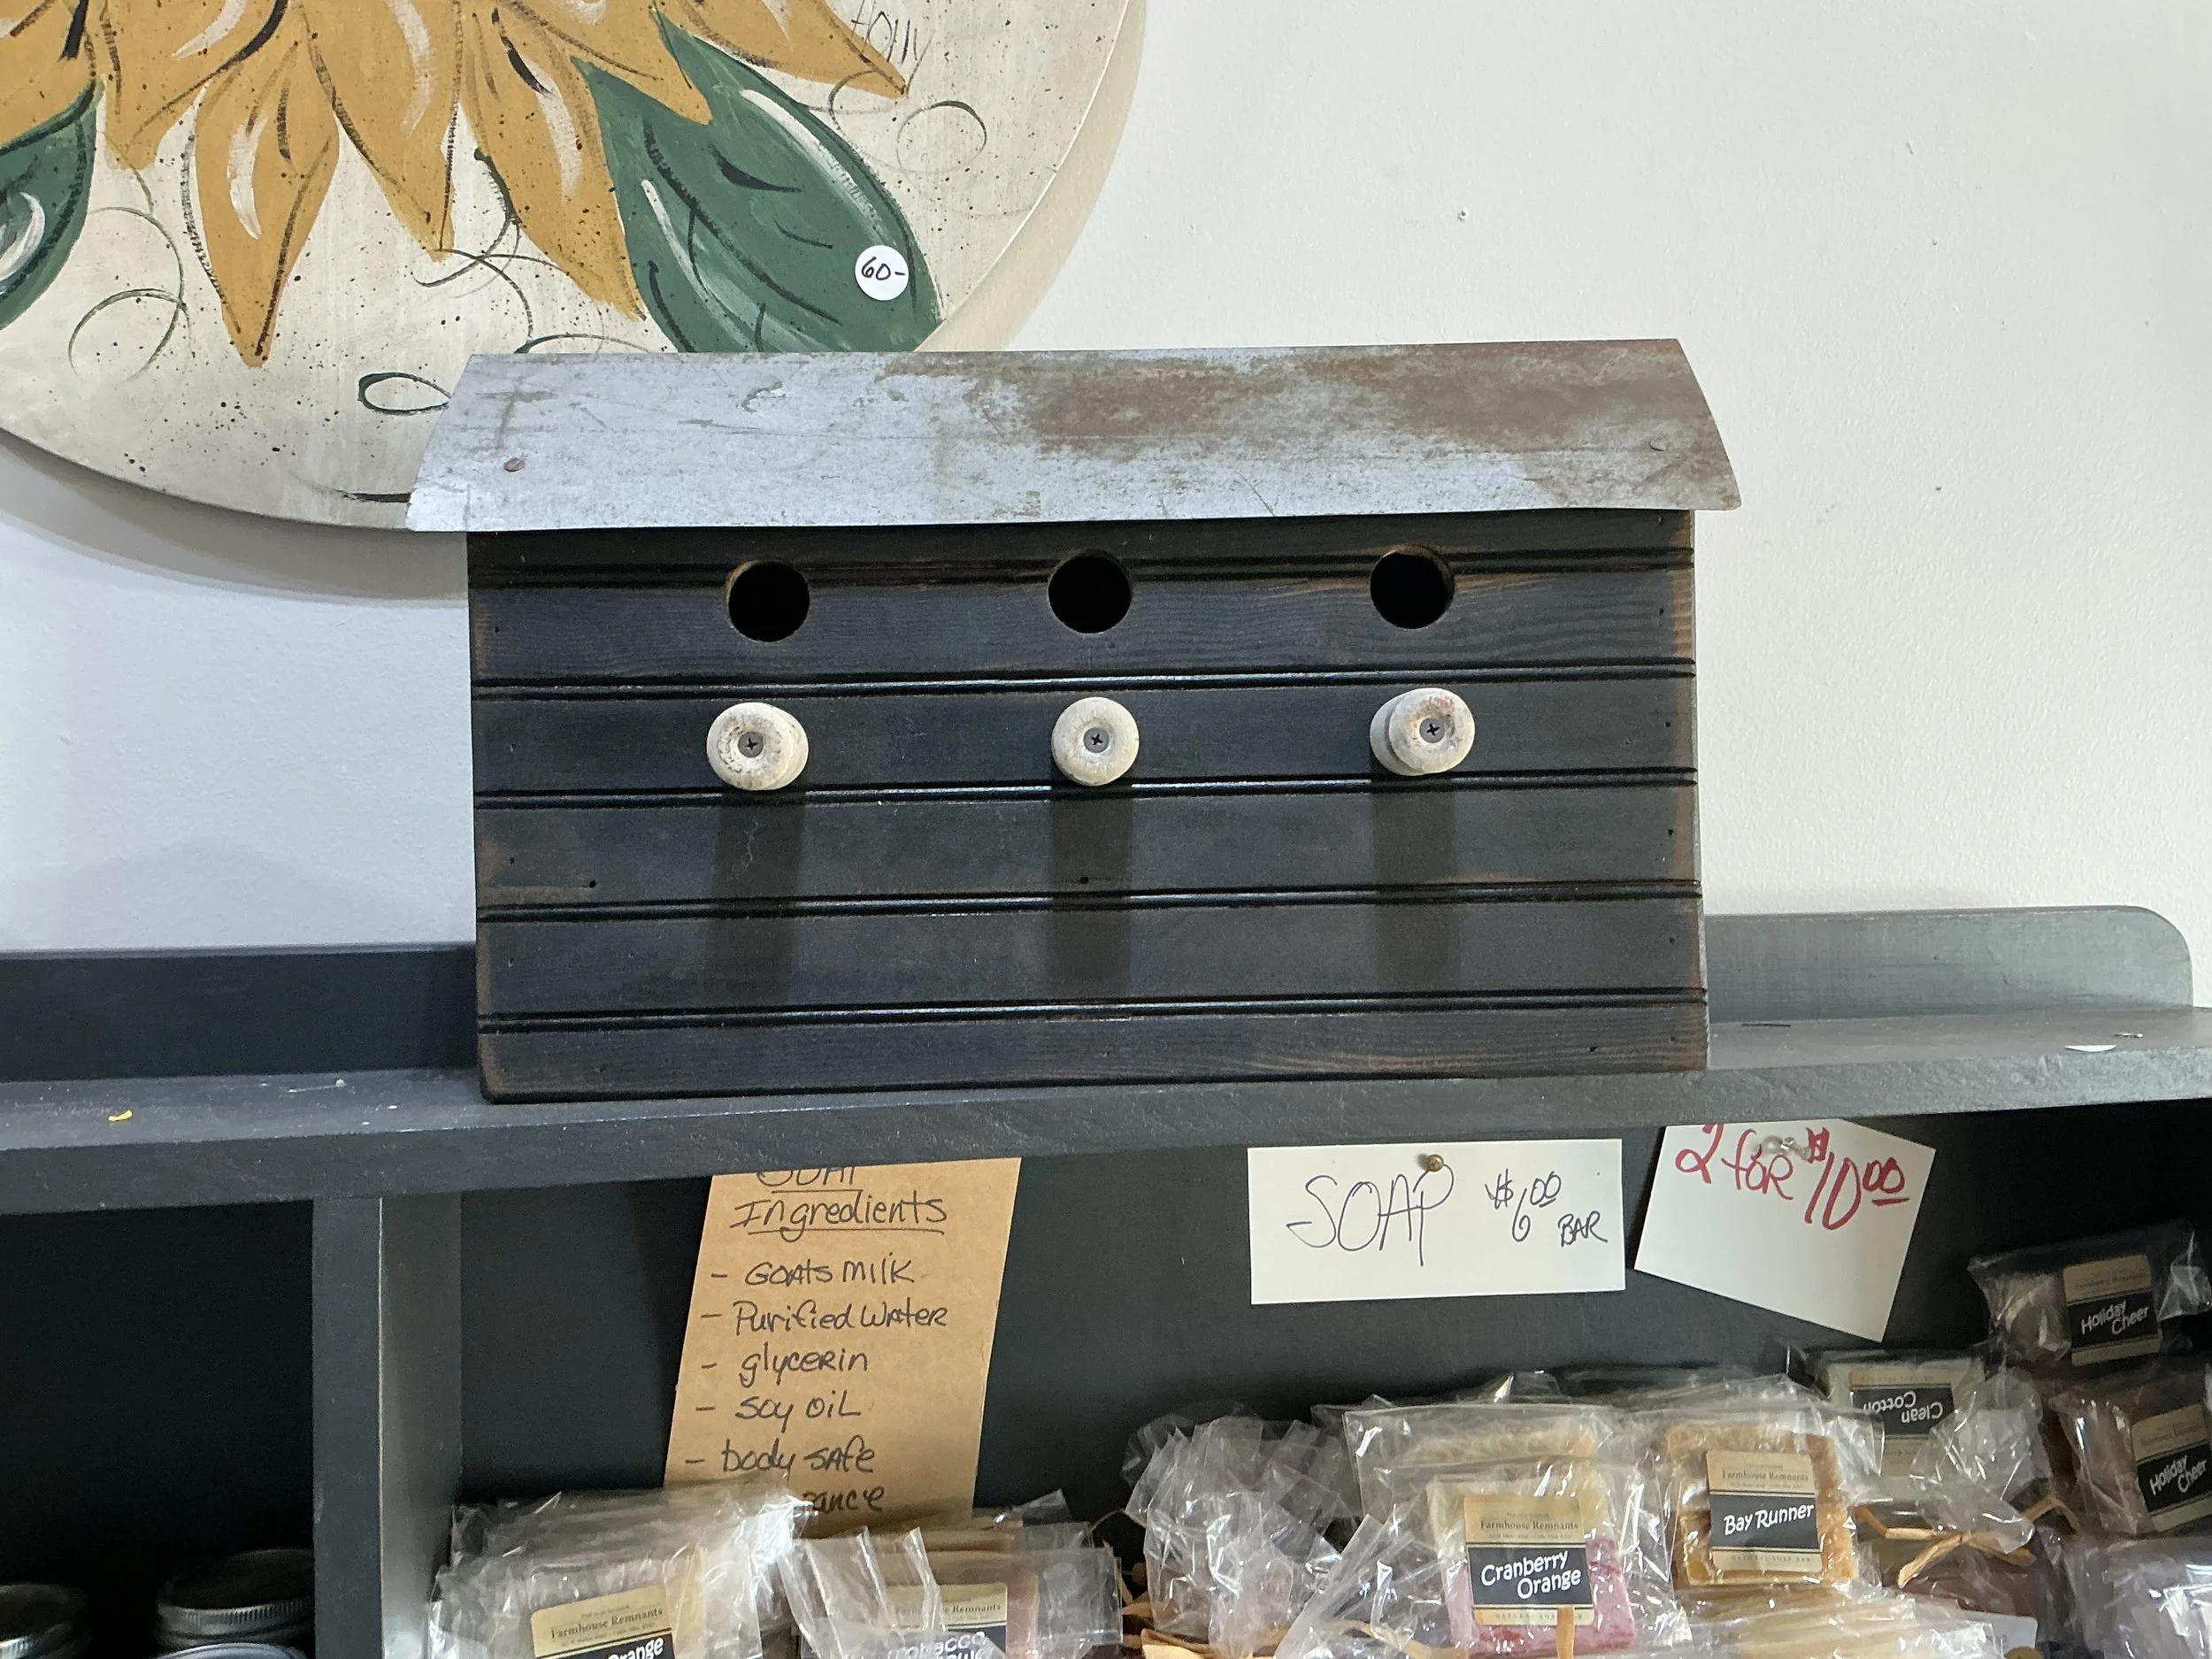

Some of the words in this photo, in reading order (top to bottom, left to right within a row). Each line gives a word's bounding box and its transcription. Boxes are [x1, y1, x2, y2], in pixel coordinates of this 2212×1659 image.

[729, 1189, 948, 1242] Ingredients
[1286, 1163, 1455, 1267] SOAP
[1557, 1210, 1608, 1248] BAR
[733, 1299, 856, 1336] Purified
[2081, 1300, 2126, 1335] Holiday
[2111, 1306, 2149, 1335] Cheer
[1863, 1391, 1916, 1413] Cotton
[1901, 1402, 1944, 1424] Clean
[721, 1438, 796, 1486] body
[2149, 1454, 2188, 1496] Holiday
[2177, 1459, 2208, 1494] Cheer
[1479, 1519, 1530, 1531] Farmhouse
[1532, 1520, 1579, 1531] Remnants
[1723, 1513, 1753, 1536] Bay
[1755, 1504, 1815, 1529] Runner
[1480, 1549, 1569, 1586] Cranberry
[1517, 1568, 1582, 1600] Orange
[550, 1618, 609, 1640] Farmhouse
[611, 1607, 664, 1626] Remnants
